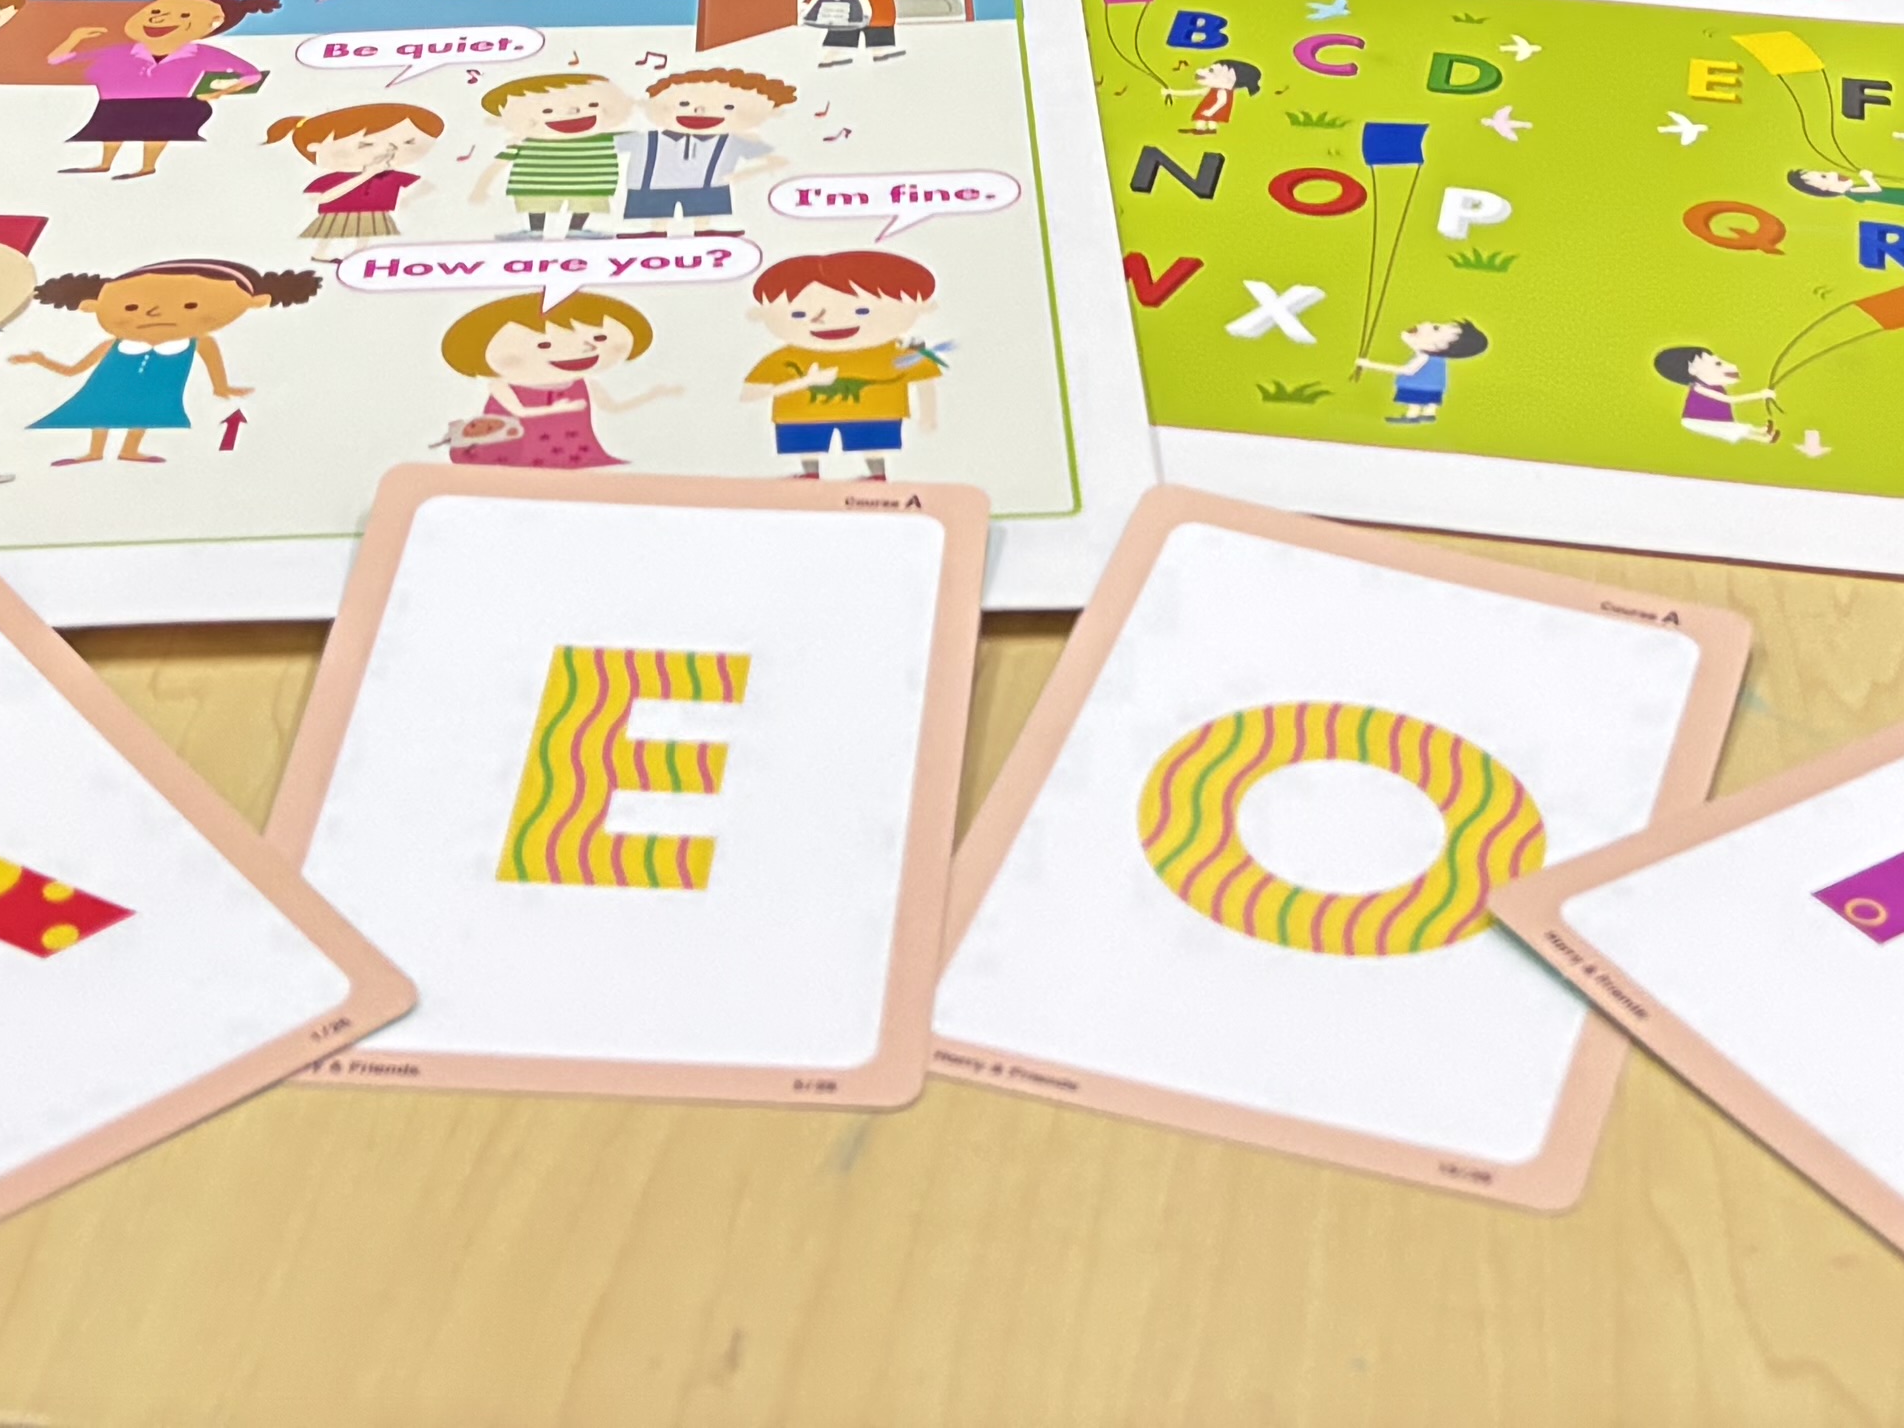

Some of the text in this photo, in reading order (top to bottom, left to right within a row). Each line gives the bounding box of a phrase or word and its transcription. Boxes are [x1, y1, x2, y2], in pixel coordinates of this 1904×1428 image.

[323, 36, 525, 59] Be quiet.
[1166, 10, 1229, 49] B
[1293, 33, 1365, 77] C
[1427, 52, 1503, 95] D
[1687, 58, 1744, 104] E
[1841, 77, 1893, 120] F
[796, 183, 996, 206] I'm fine.
[1130, 145, 1226, 200] N
[1268, 167, 1368, 216] O
[1437, 186, 1512, 240] P
[1683, 200, 1786, 256] Q
[363, 249, 732, 279] How are you?
[1224, 280, 1326, 345] X
[905, 494, 921, 509] A
[1662, 610, 1680, 626] A
[496, 645, 751, 892] E
[1137, 701, 1547, 958] O
